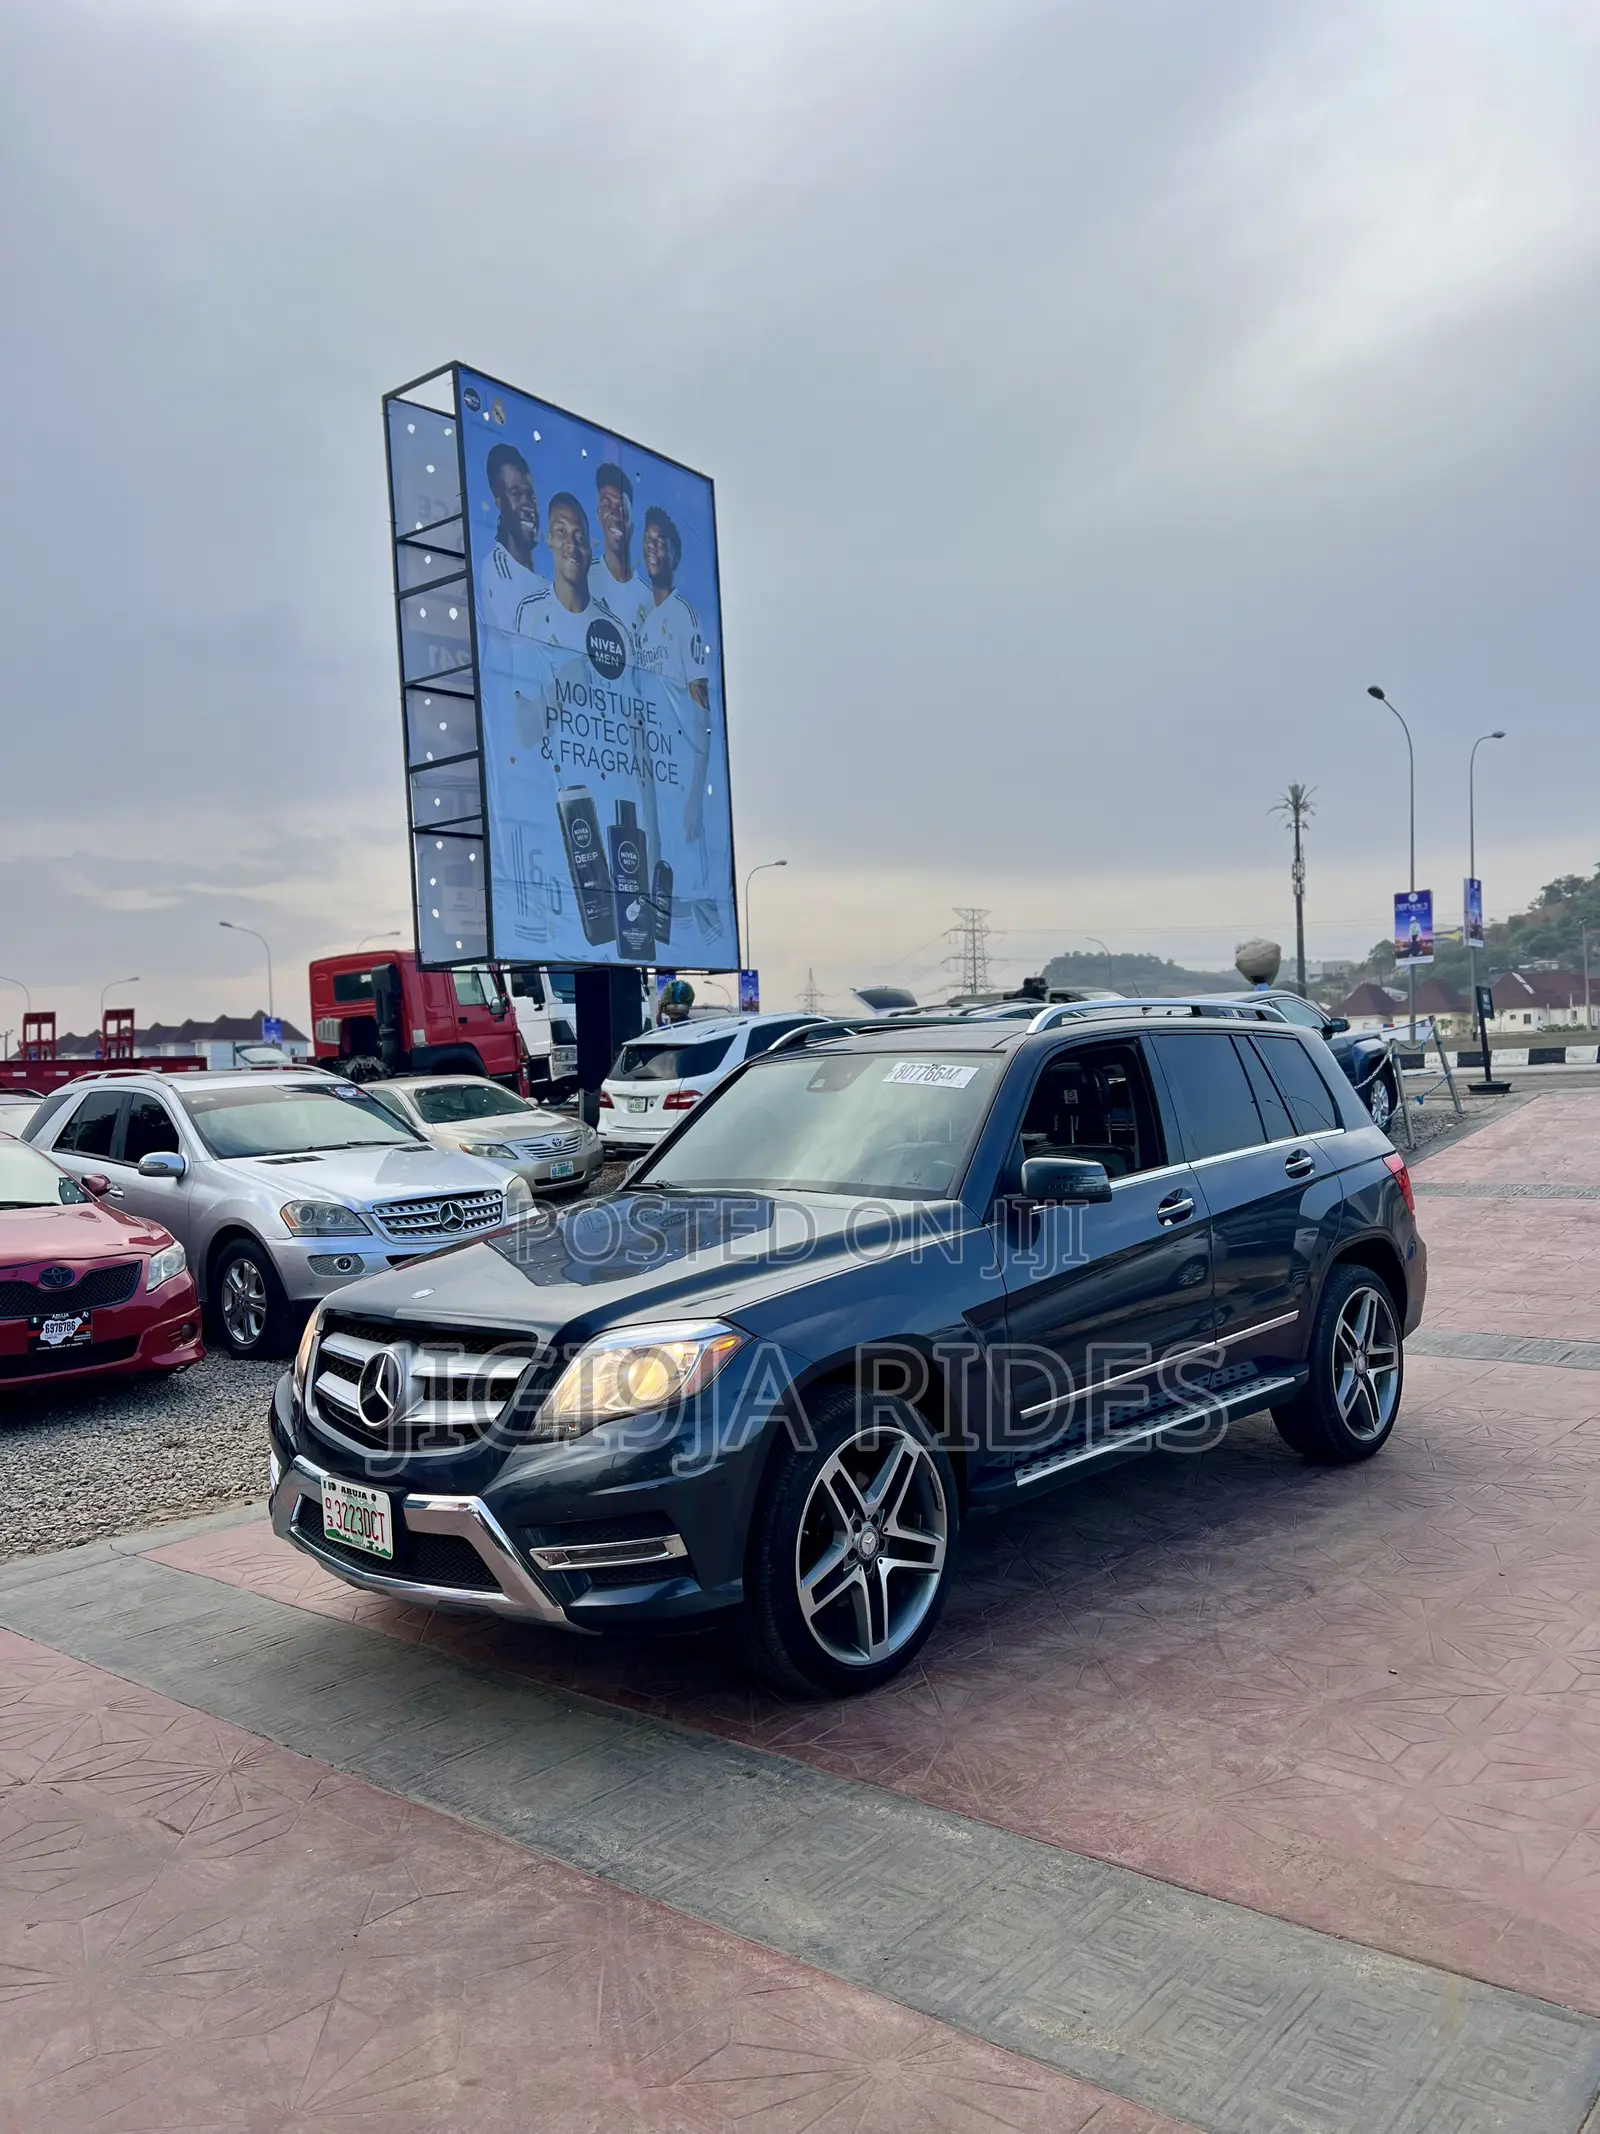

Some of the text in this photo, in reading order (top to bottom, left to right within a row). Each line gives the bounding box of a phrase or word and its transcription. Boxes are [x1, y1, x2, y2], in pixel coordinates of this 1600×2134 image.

[590, 636, 623, 656] NIVEA
[595, 651, 619, 667] MEN
[555, 678, 662, 729] MOISTURE,
[546, 706, 672, 756] PROTECTION
[541, 736, 679, 785] & FRAGRANCE
[574, 827, 589, 836] NIVEA
[575, 851, 599, 864] DEEP
[620, 851, 637, 860] NIVEA
[618, 883, 640, 893] DEEP
[45, 1321, 76, 1334] 6976786
[341, 1486, 367, 1500] ABUJA
[334, 1499, 384, 1544] 3223DCT
